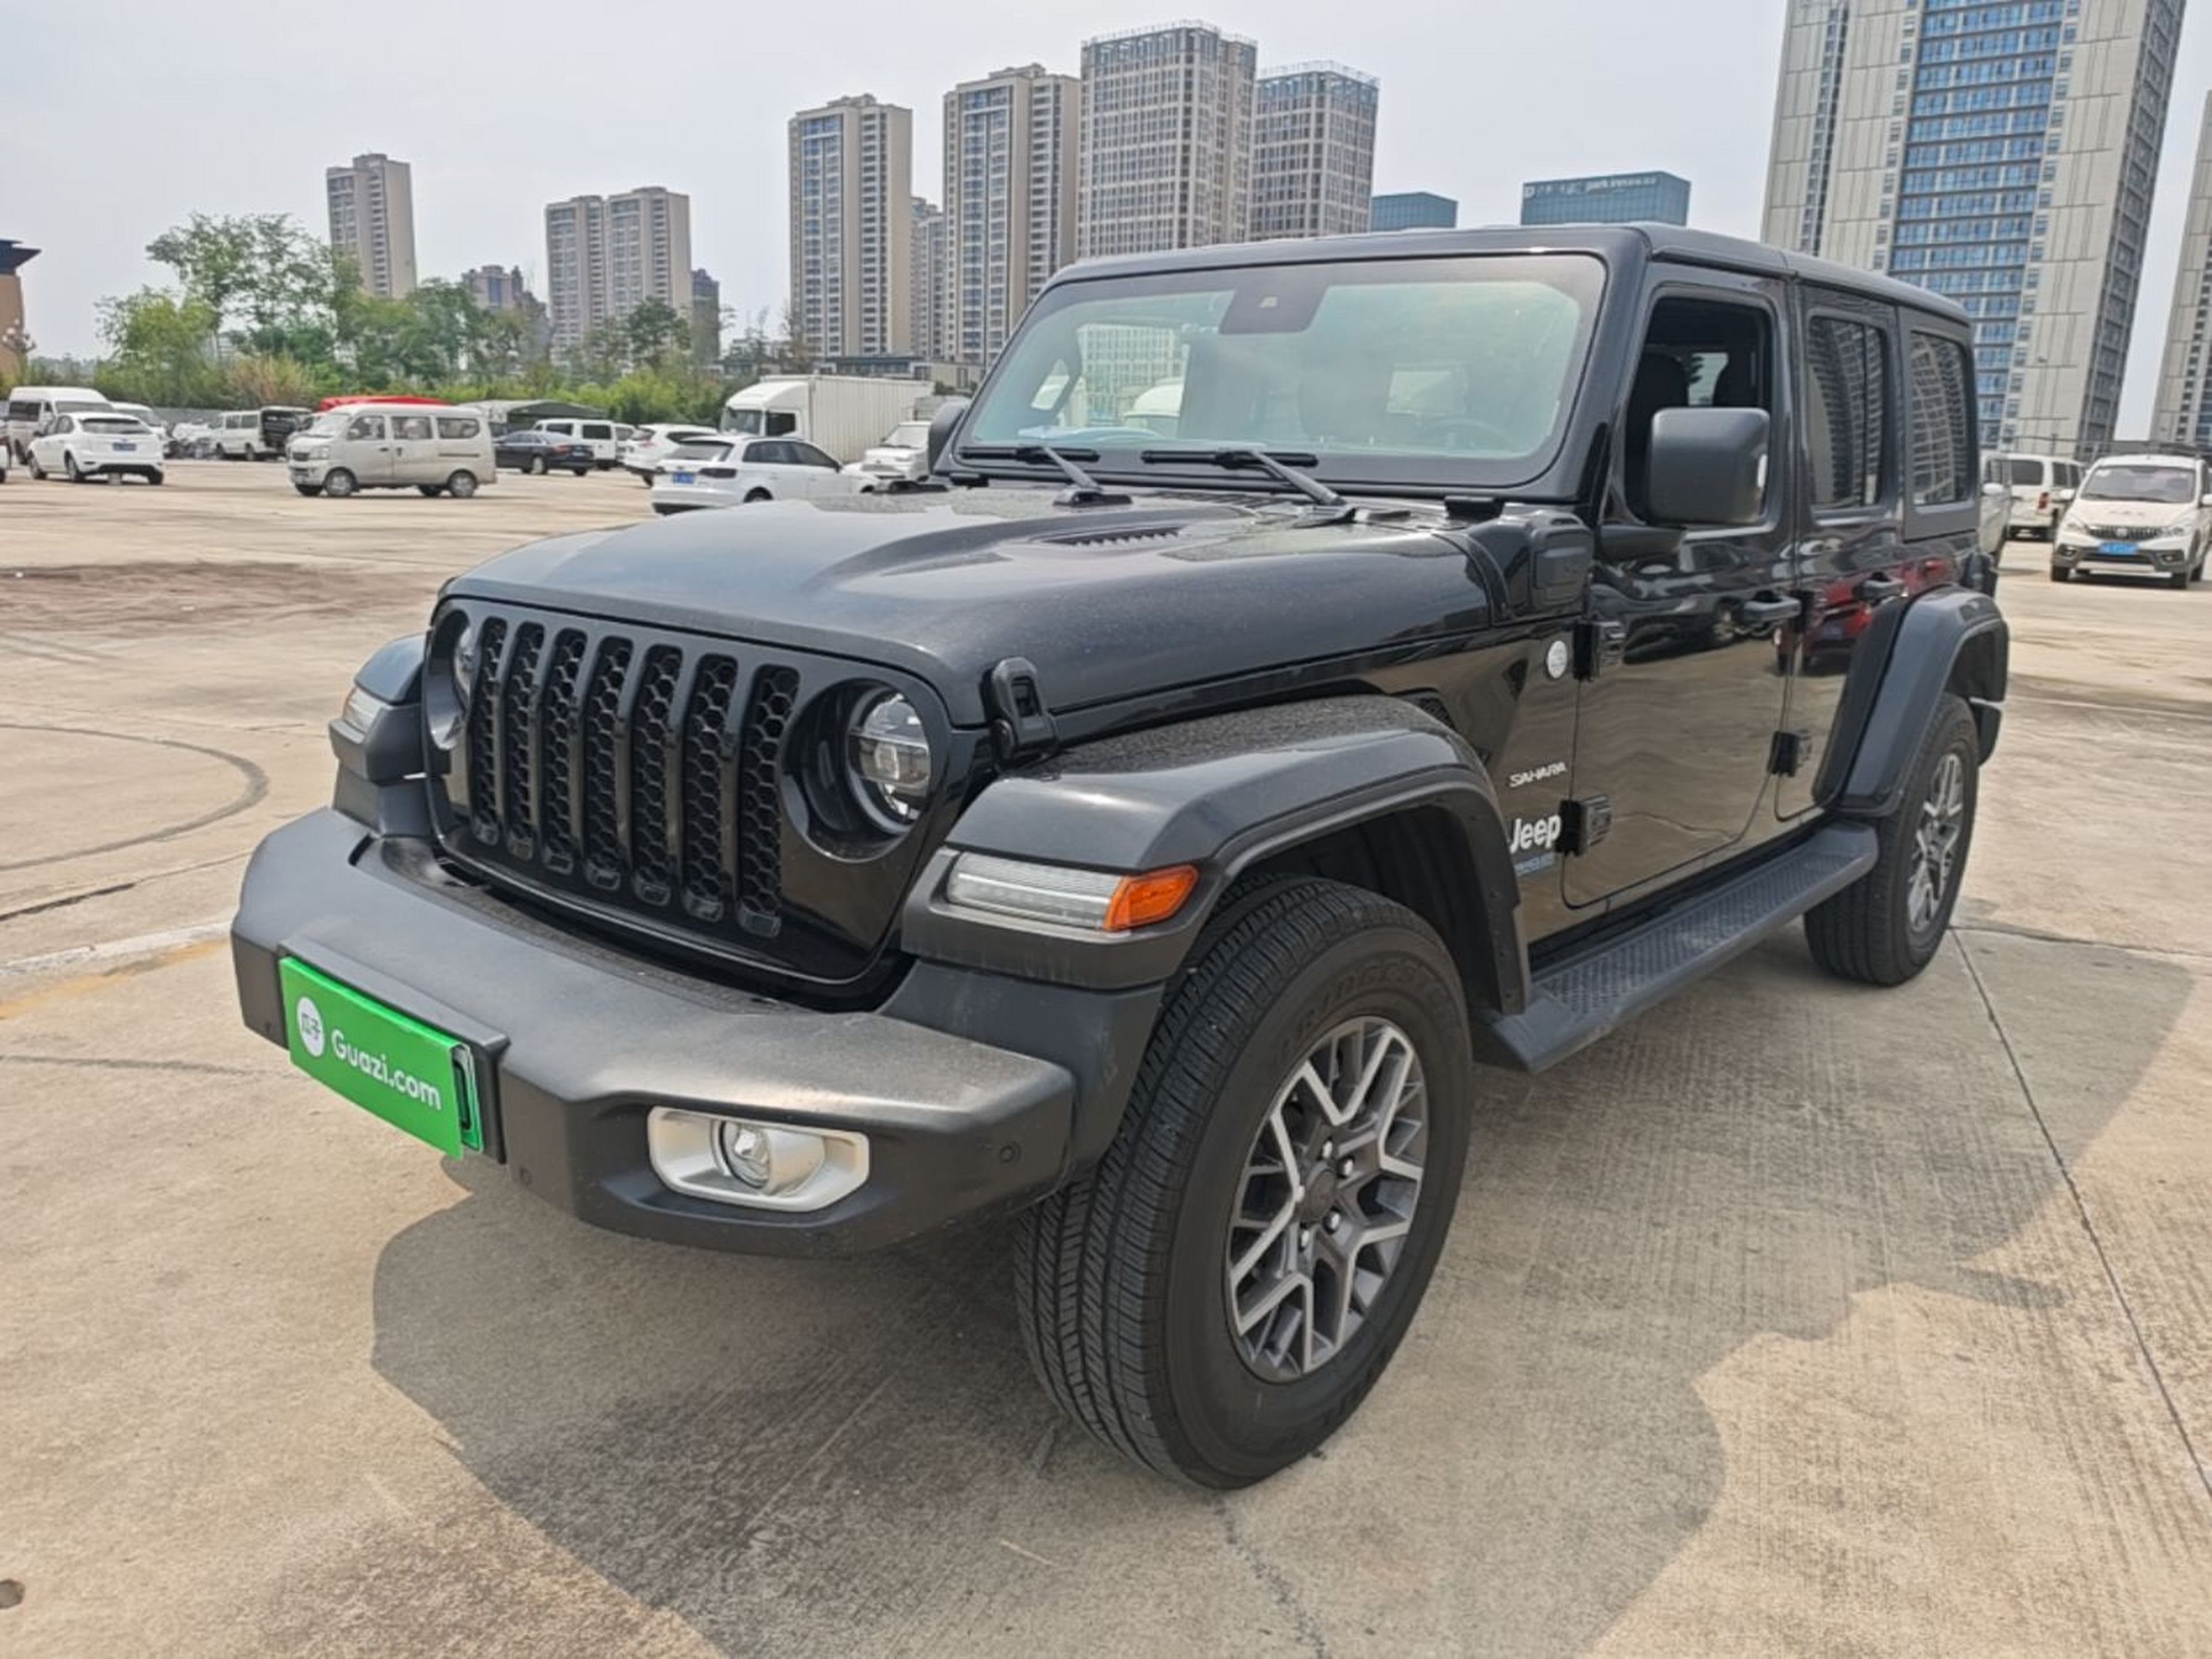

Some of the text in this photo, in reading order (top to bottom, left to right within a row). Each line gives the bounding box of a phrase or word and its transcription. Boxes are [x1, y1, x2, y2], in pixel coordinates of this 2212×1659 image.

[1509, 762, 1566, 787] SAHARA
[1509, 814, 1562, 855] Jeep
[332, 1029, 441, 1110] Guazi.com
